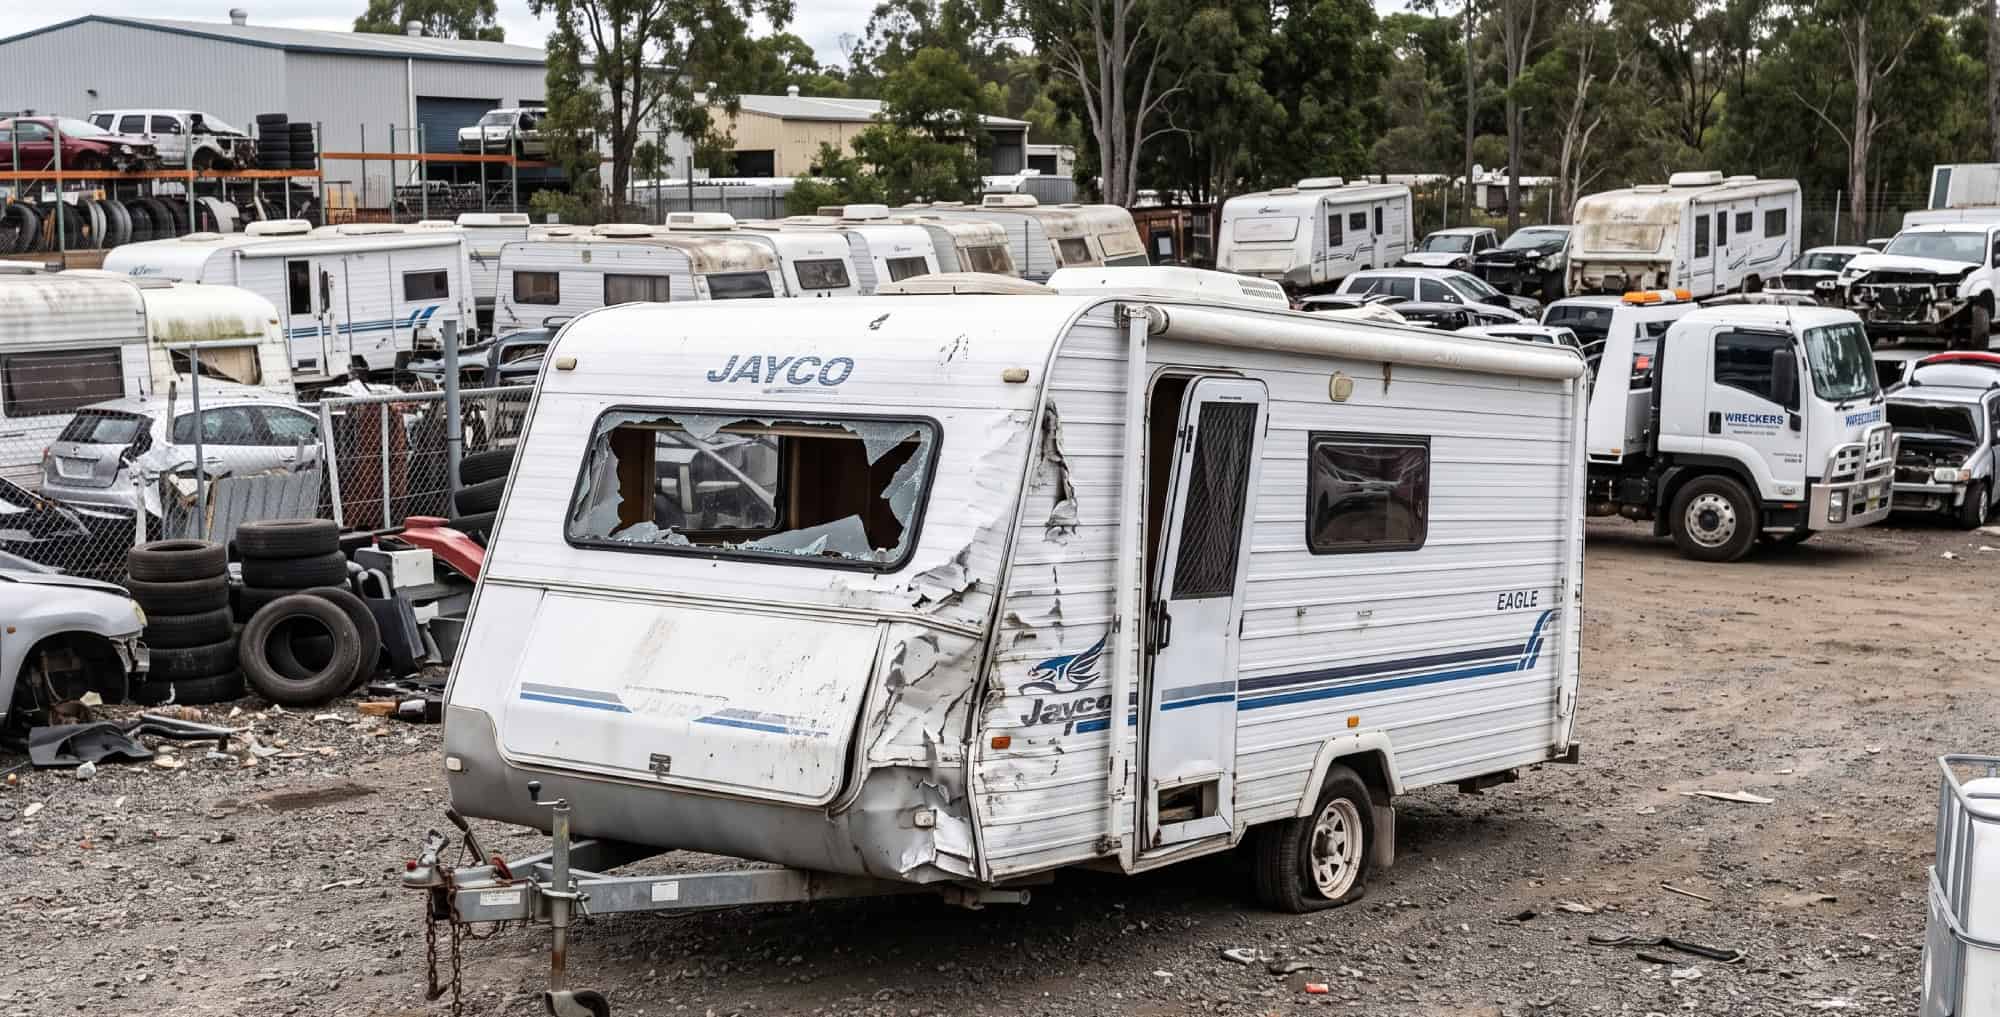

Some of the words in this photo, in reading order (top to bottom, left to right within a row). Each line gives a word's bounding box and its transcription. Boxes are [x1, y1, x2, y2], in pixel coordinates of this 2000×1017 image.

[706, 354, 855, 387] JAYCO
[1725, 412, 1784, 425] WRECKERS
[1497, 590, 1538, 610] EAGLE
